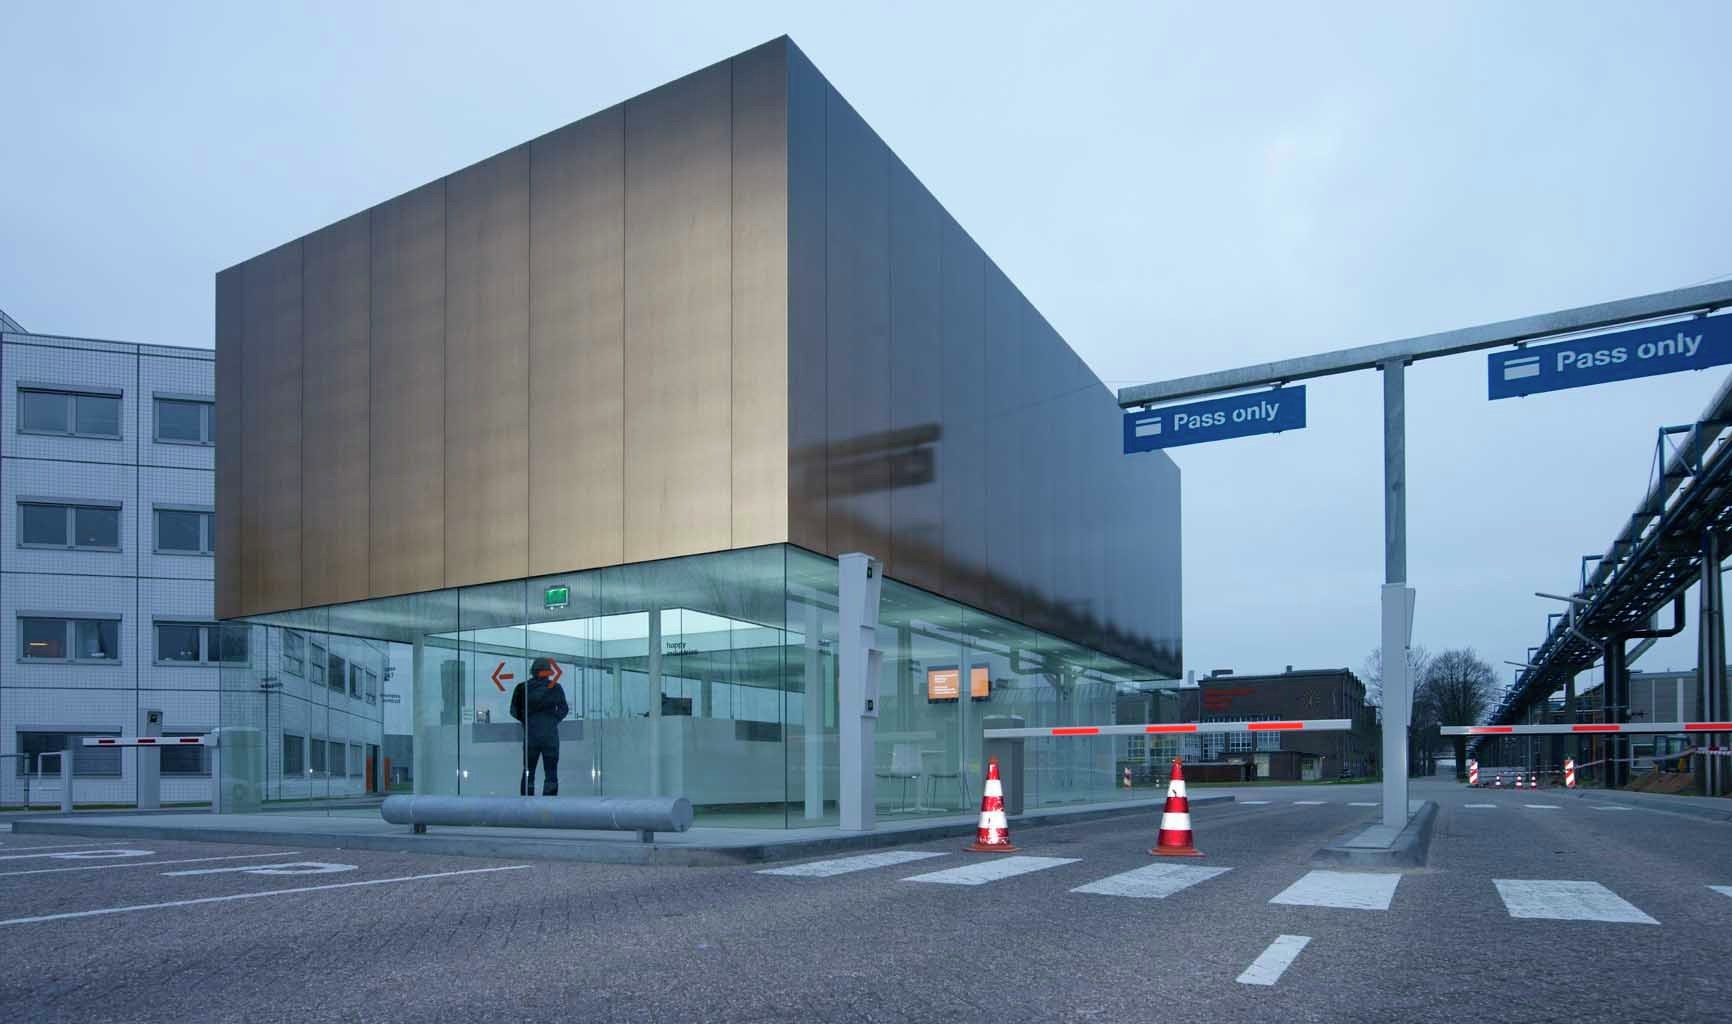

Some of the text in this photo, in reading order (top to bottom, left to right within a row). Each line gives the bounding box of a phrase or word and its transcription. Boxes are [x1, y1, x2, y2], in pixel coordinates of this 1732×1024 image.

[1556, 332, 1703, 372] Pass only
[1173, 401, 1280, 431] Pass only
